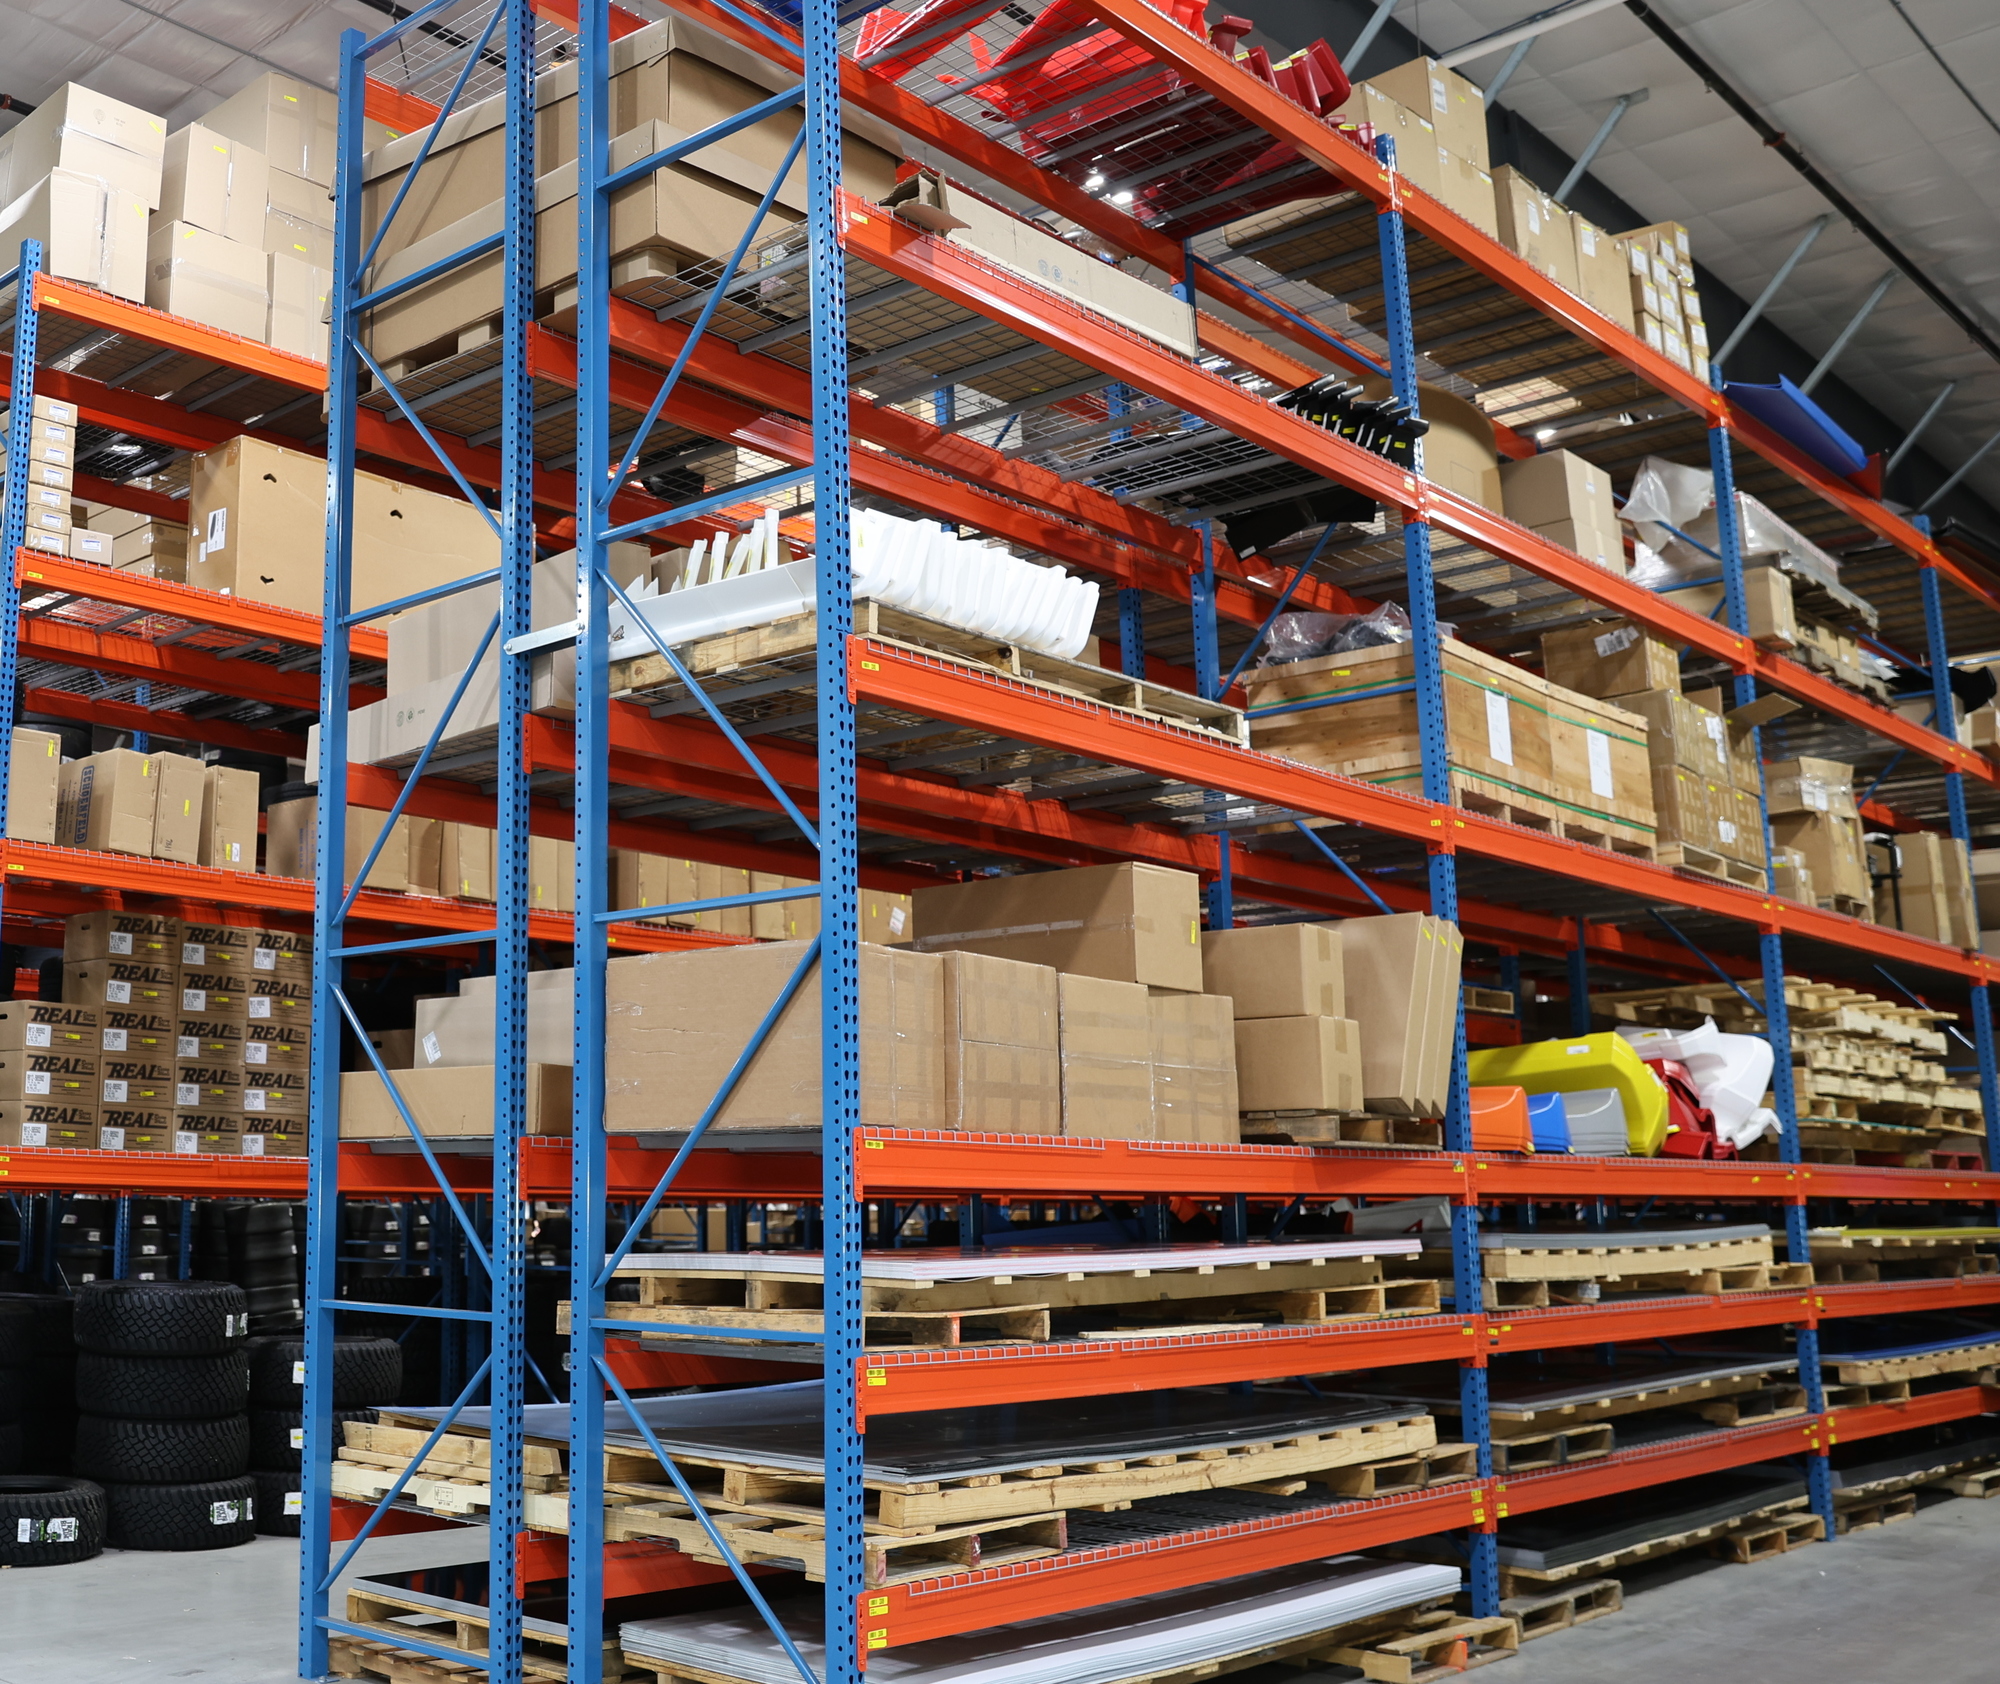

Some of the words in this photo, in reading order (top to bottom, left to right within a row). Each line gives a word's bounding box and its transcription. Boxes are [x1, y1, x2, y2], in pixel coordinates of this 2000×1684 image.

[76, 767, 93, 842] SCHOENFELD
[112, 915, 178, 938] REAL
[184, 925, 247, 948] REAL
[255, 933, 313, 954] REAL
[109, 962, 175, 985] REAL
[183, 973, 246, 993] REAL
[251, 979, 311, 1000] REAL
[28, 1005, 97, 1027] REAL
[105, 1011, 171, 1033] REAL
[178, 1020, 242, 1041] REAL
[247, 1024, 307, 1045] REAL
[26, 1054, 95, 1076] REAL
[104, 1061, 171, 1081] REAL
[178, 1066, 241, 1086] REAL
[245, 1071, 305, 1090] REAL
[24, 1104, 93, 1125] REAL
[102, 1110, 168, 1130] REAL
[177, 1114, 239, 1133] REAL
[243, 1117, 304, 1136] REAL
